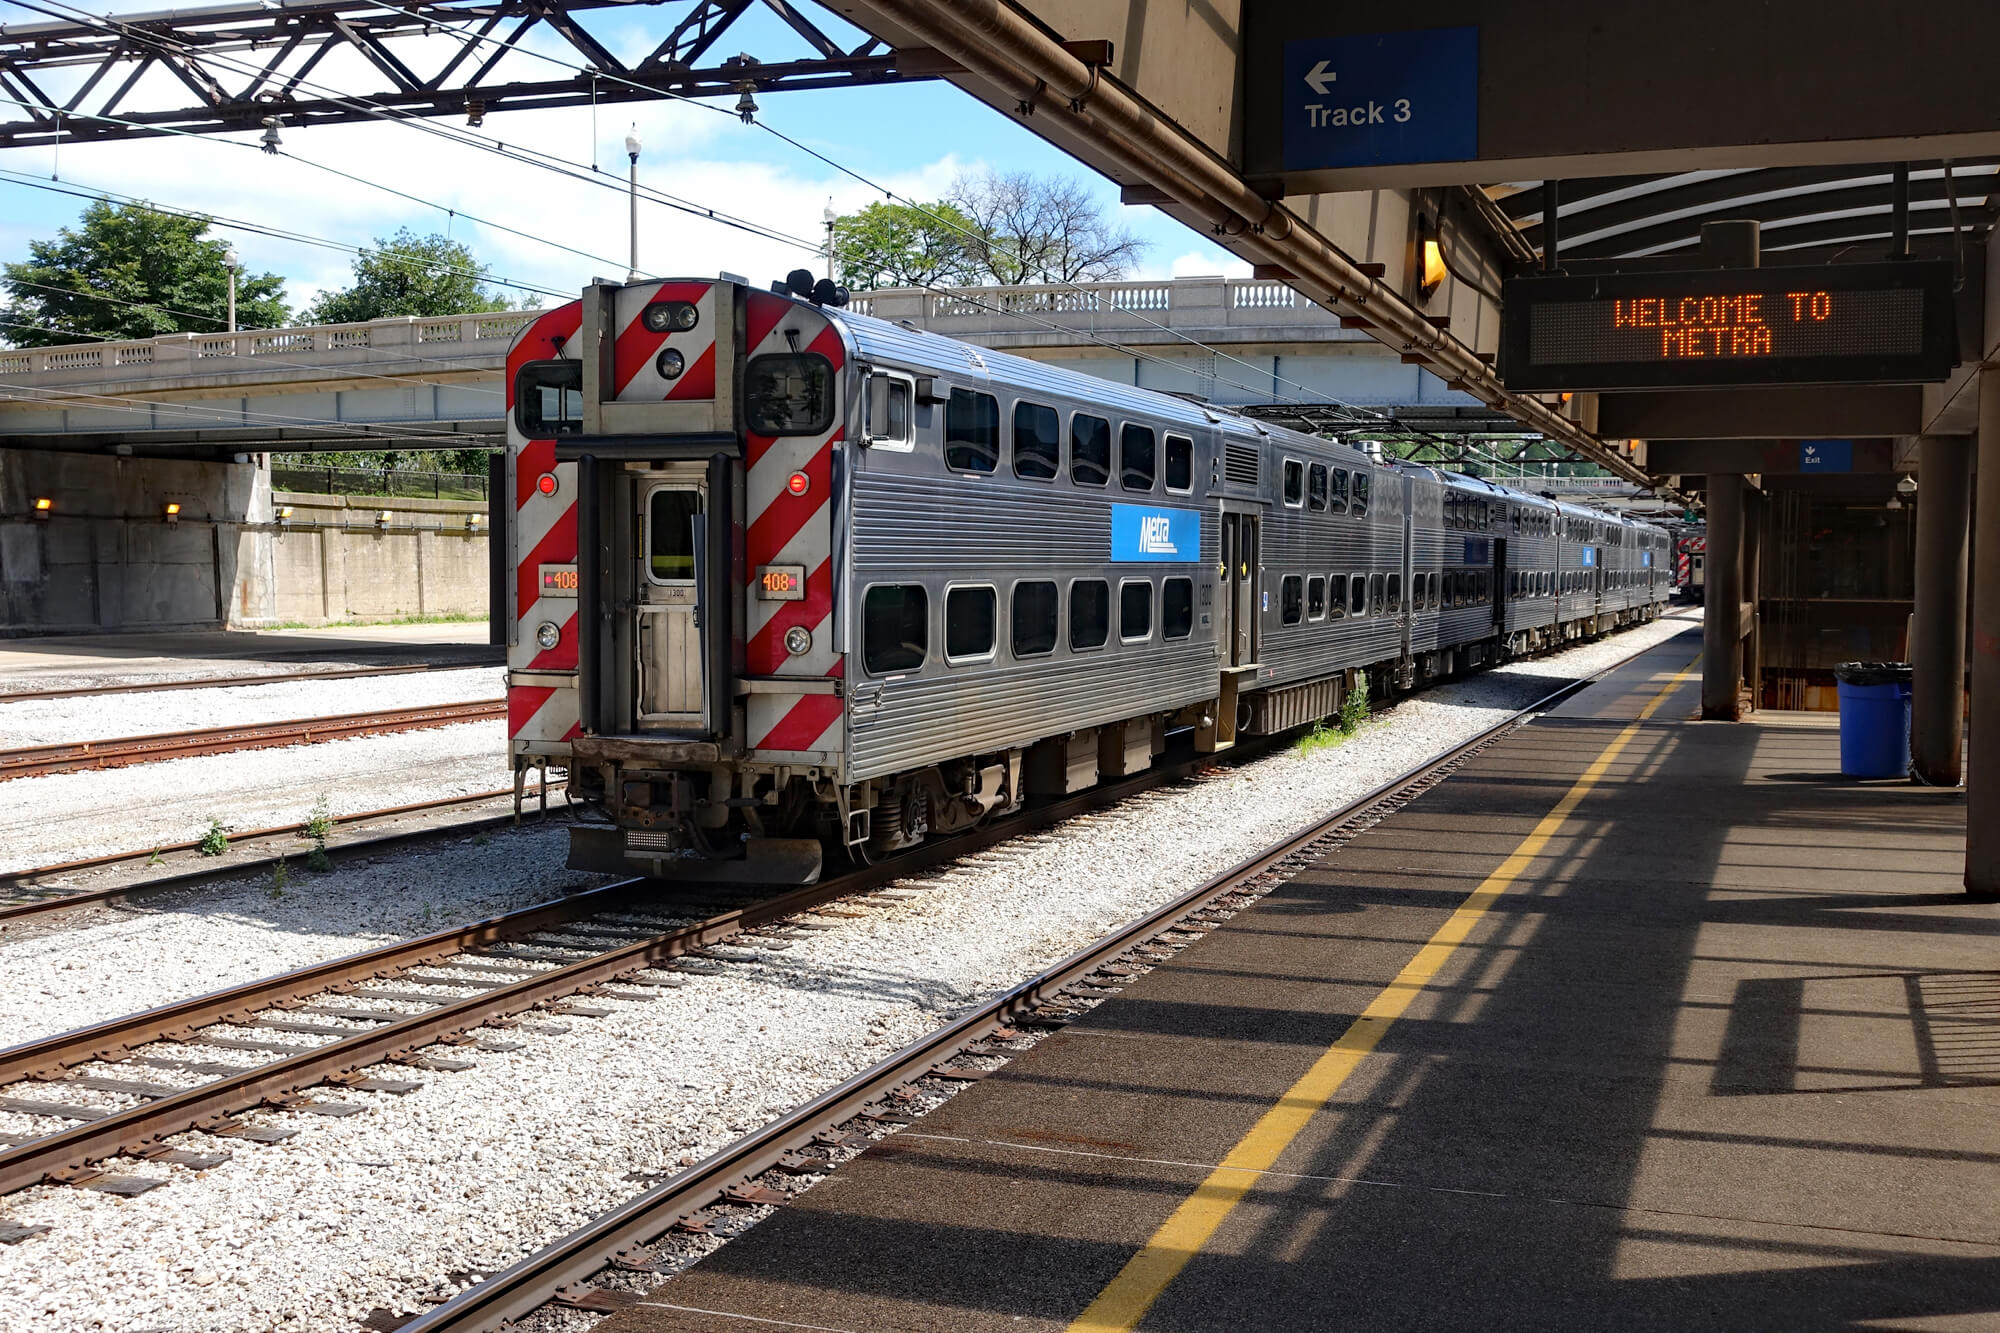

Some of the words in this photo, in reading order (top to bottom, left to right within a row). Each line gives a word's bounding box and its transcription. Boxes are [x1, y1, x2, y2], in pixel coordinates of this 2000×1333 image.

[1304, 101, 1384, 128] Track
[1393, 98, 1411, 122] 3
[1614, 294, 1763, 328] WELCOME
[1786, 291, 1831, 322] TO
[1662, 326, 1771, 356] METRA
[1805, 456, 1821, 464] Exit
[1138, 511, 1177, 553] Metra
[553, 571, 578, 589] 408
[762, 572, 789, 591] 408
